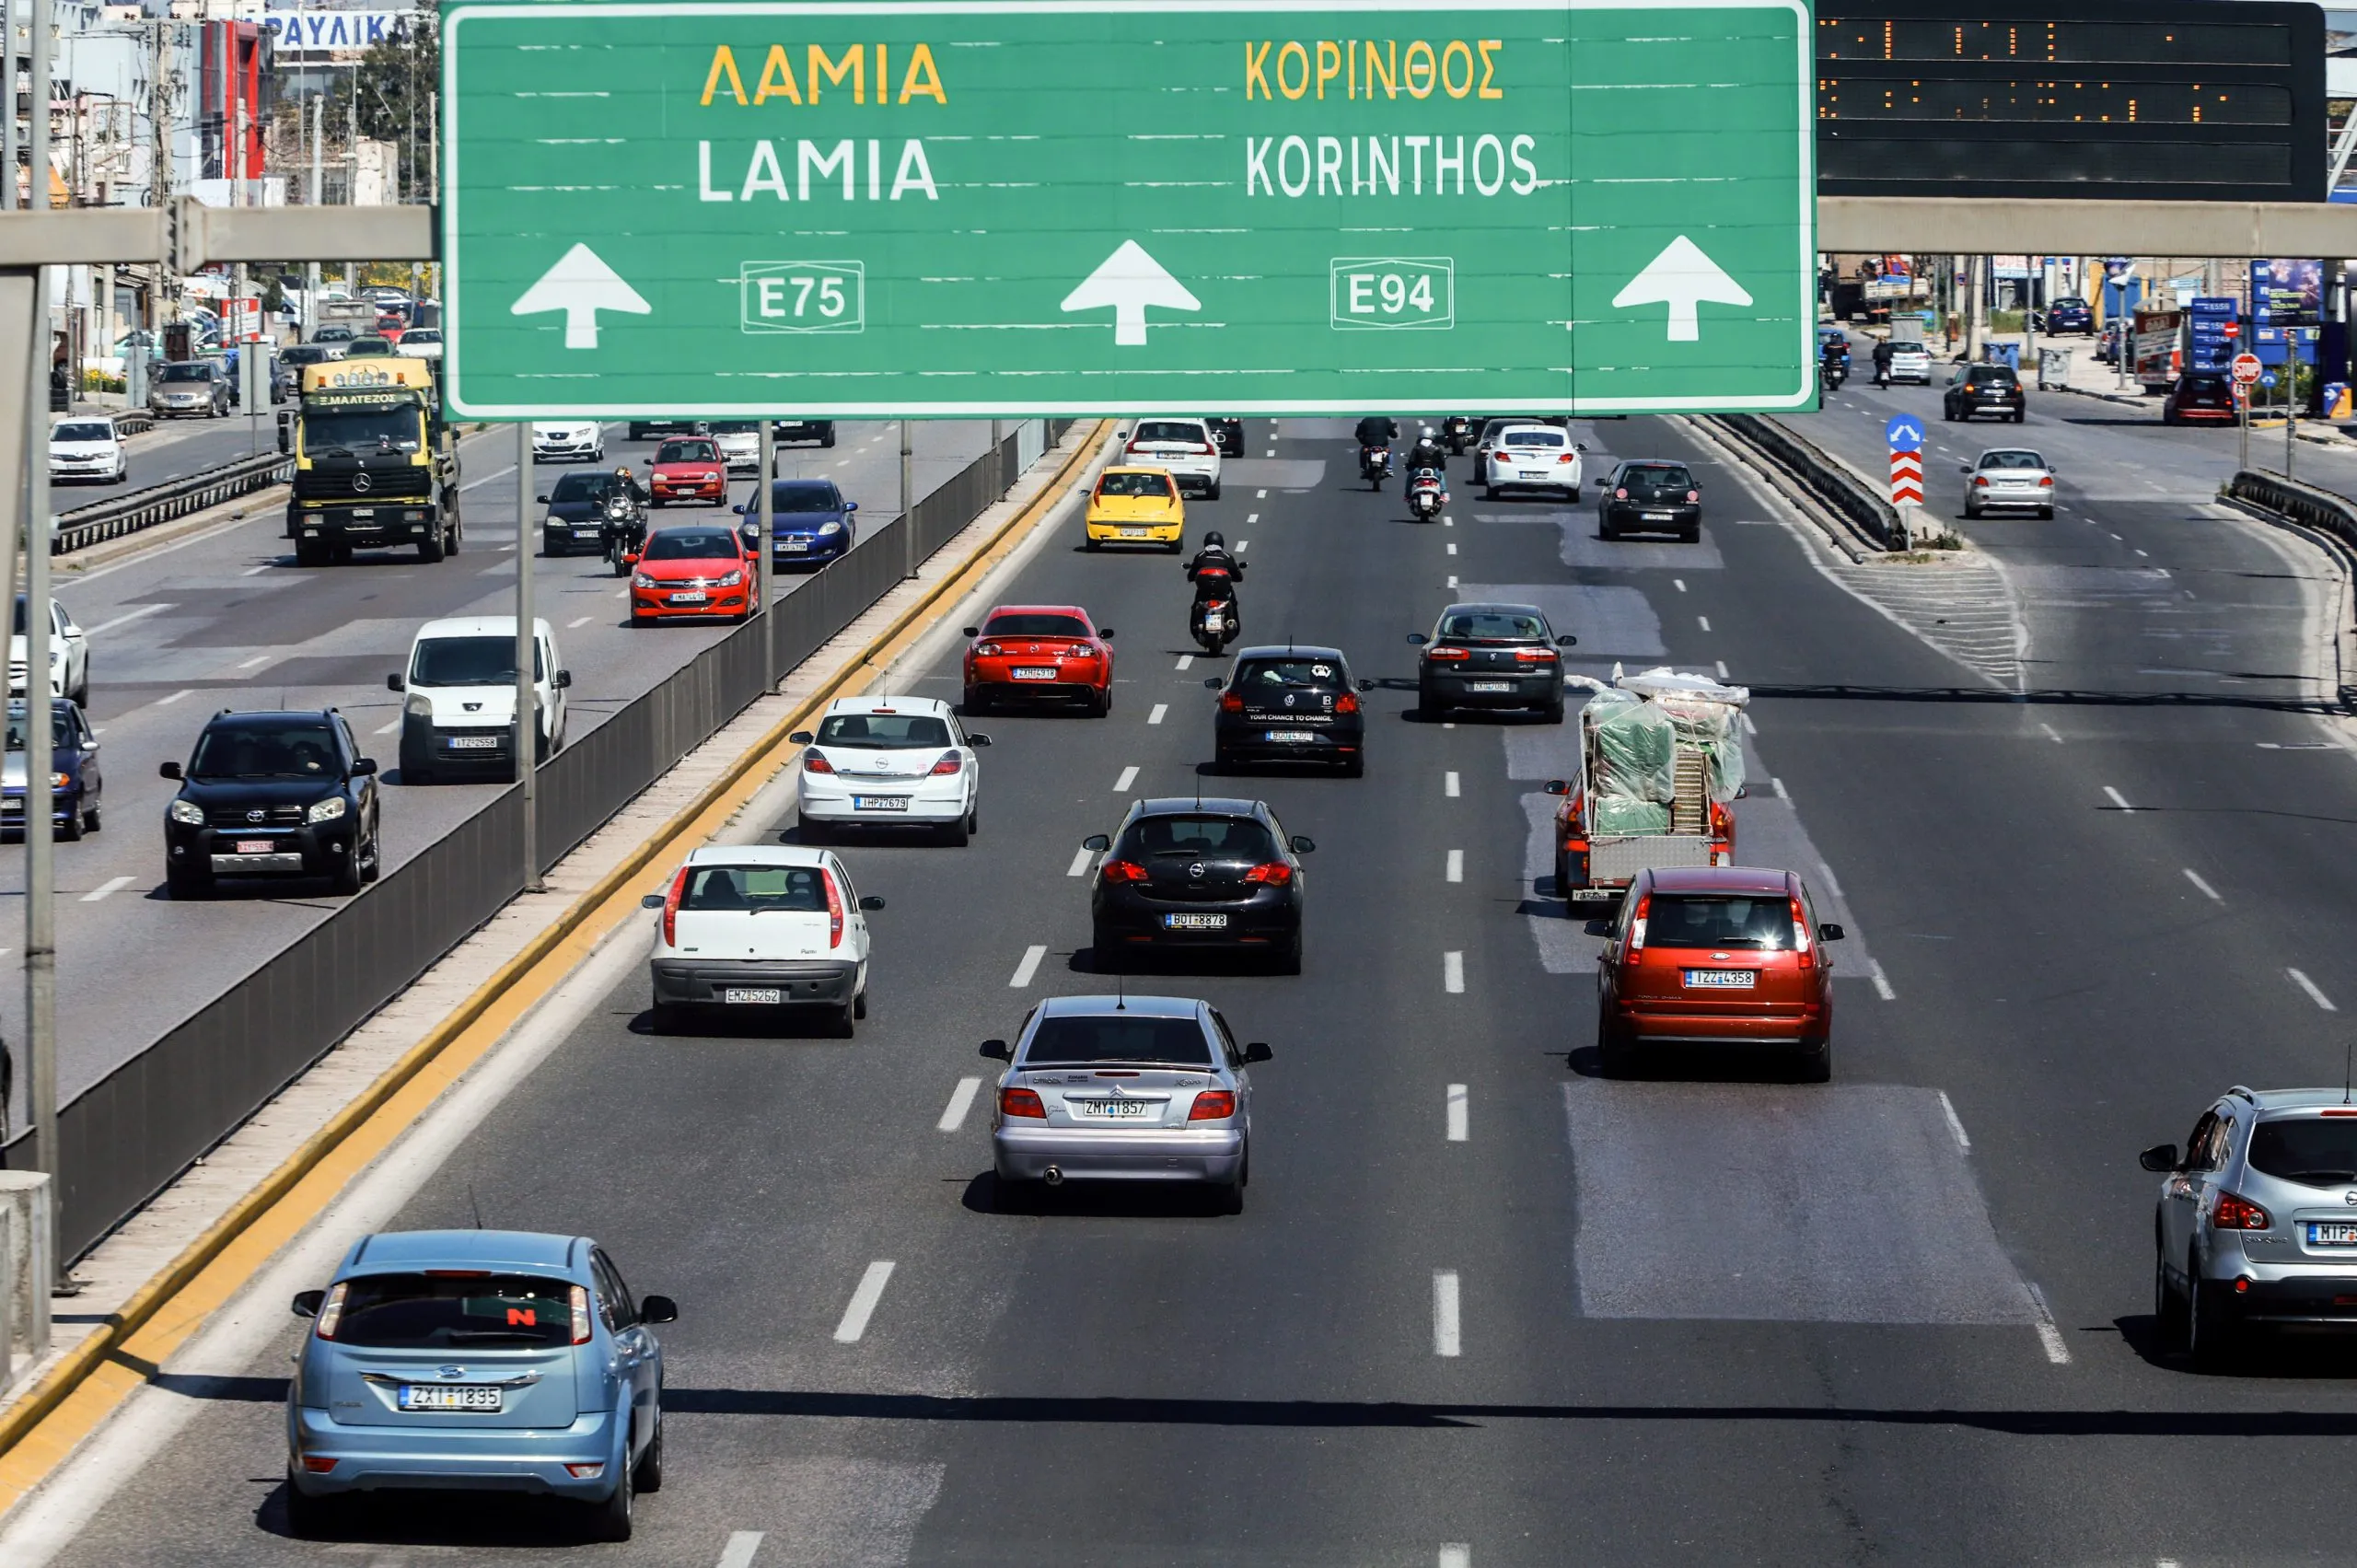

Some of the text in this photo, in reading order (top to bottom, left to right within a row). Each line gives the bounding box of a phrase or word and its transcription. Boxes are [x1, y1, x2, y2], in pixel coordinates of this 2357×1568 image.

[700, 43, 947, 106] ΛΑΜΙΑ
[1245, 40, 1504, 100] ΚΟΡΙΝΘΟΣ
[698, 138, 939, 202] LAMIA
[1246, 134, 1538, 198] KORINTHOS
[758, 276, 845, 318] E75
[1349, 273, 1434, 314] E94
[2234, 362, 2259, 377] STOP
[507, 1307, 536, 1327] N
